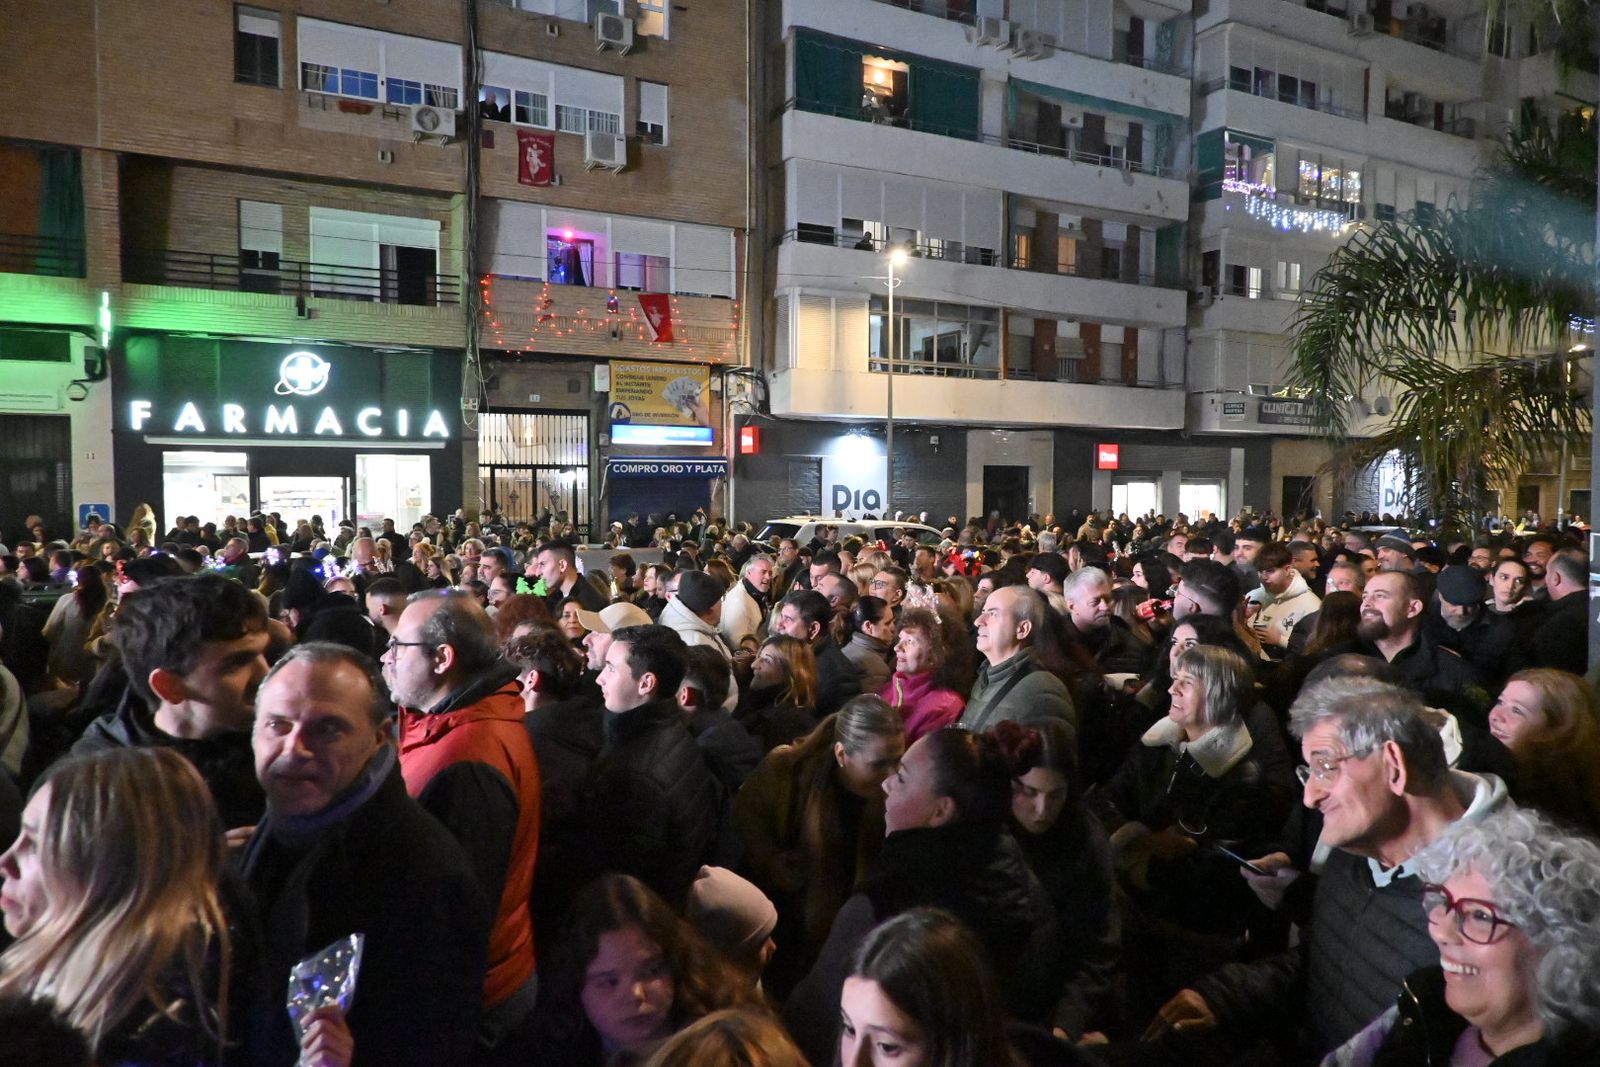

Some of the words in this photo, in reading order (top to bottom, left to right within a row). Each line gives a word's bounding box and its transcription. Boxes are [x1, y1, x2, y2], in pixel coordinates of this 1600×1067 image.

[129, 400, 450, 438] FARMACIA
[613, 463, 659, 473] COMPRO
[661, 464, 684, 474] ORO
[686, 465, 693, 474] Y
[695, 465, 726, 474] PLATA
[832, 485, 880, 510] Dia
